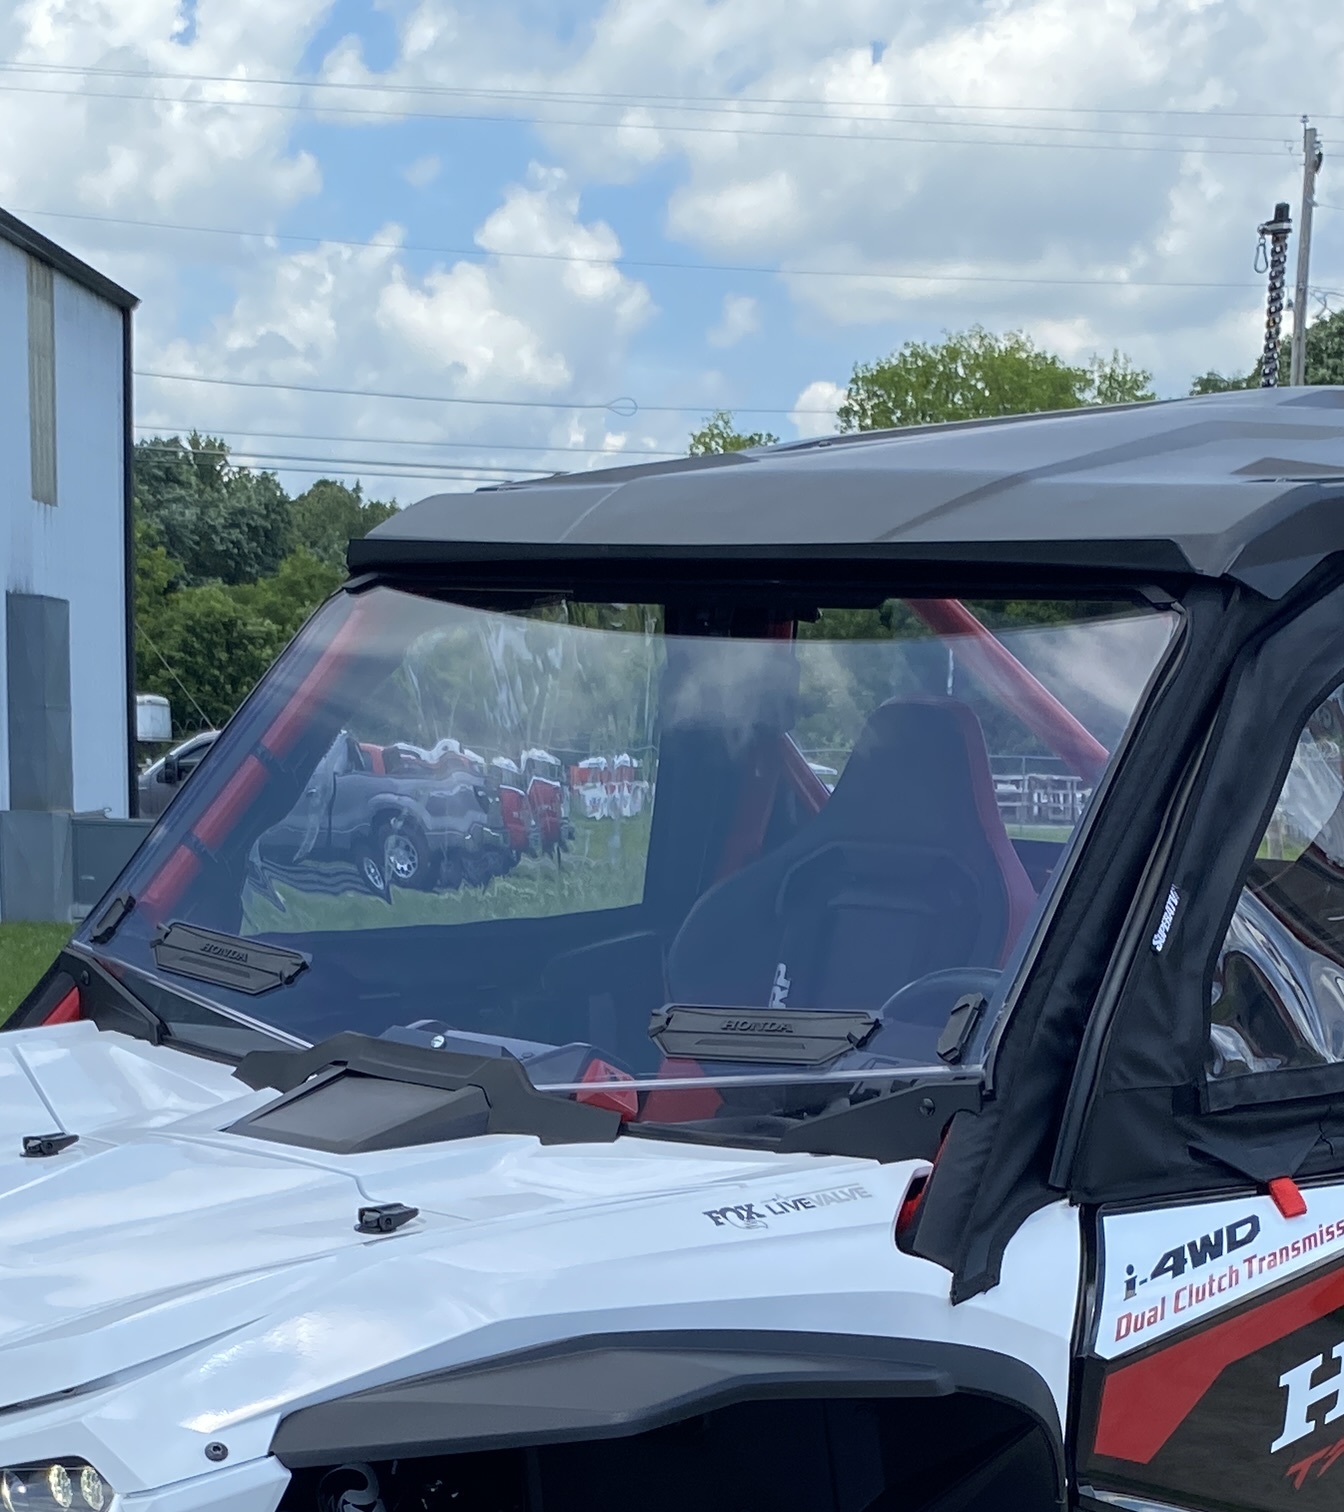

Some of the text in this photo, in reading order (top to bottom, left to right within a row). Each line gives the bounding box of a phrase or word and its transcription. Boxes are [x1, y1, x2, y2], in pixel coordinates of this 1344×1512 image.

[200, 943, 249, 963] HONDA
[720, 1019, 794, 1033] HONDA
[702, 1202, 766, 1228] FOX
[1123, 1213, 1261, 1302] i-4WD
[1114, 1296, 1166, 1342] Dual
[1173, 1264, 1240, 1314] Clutch
